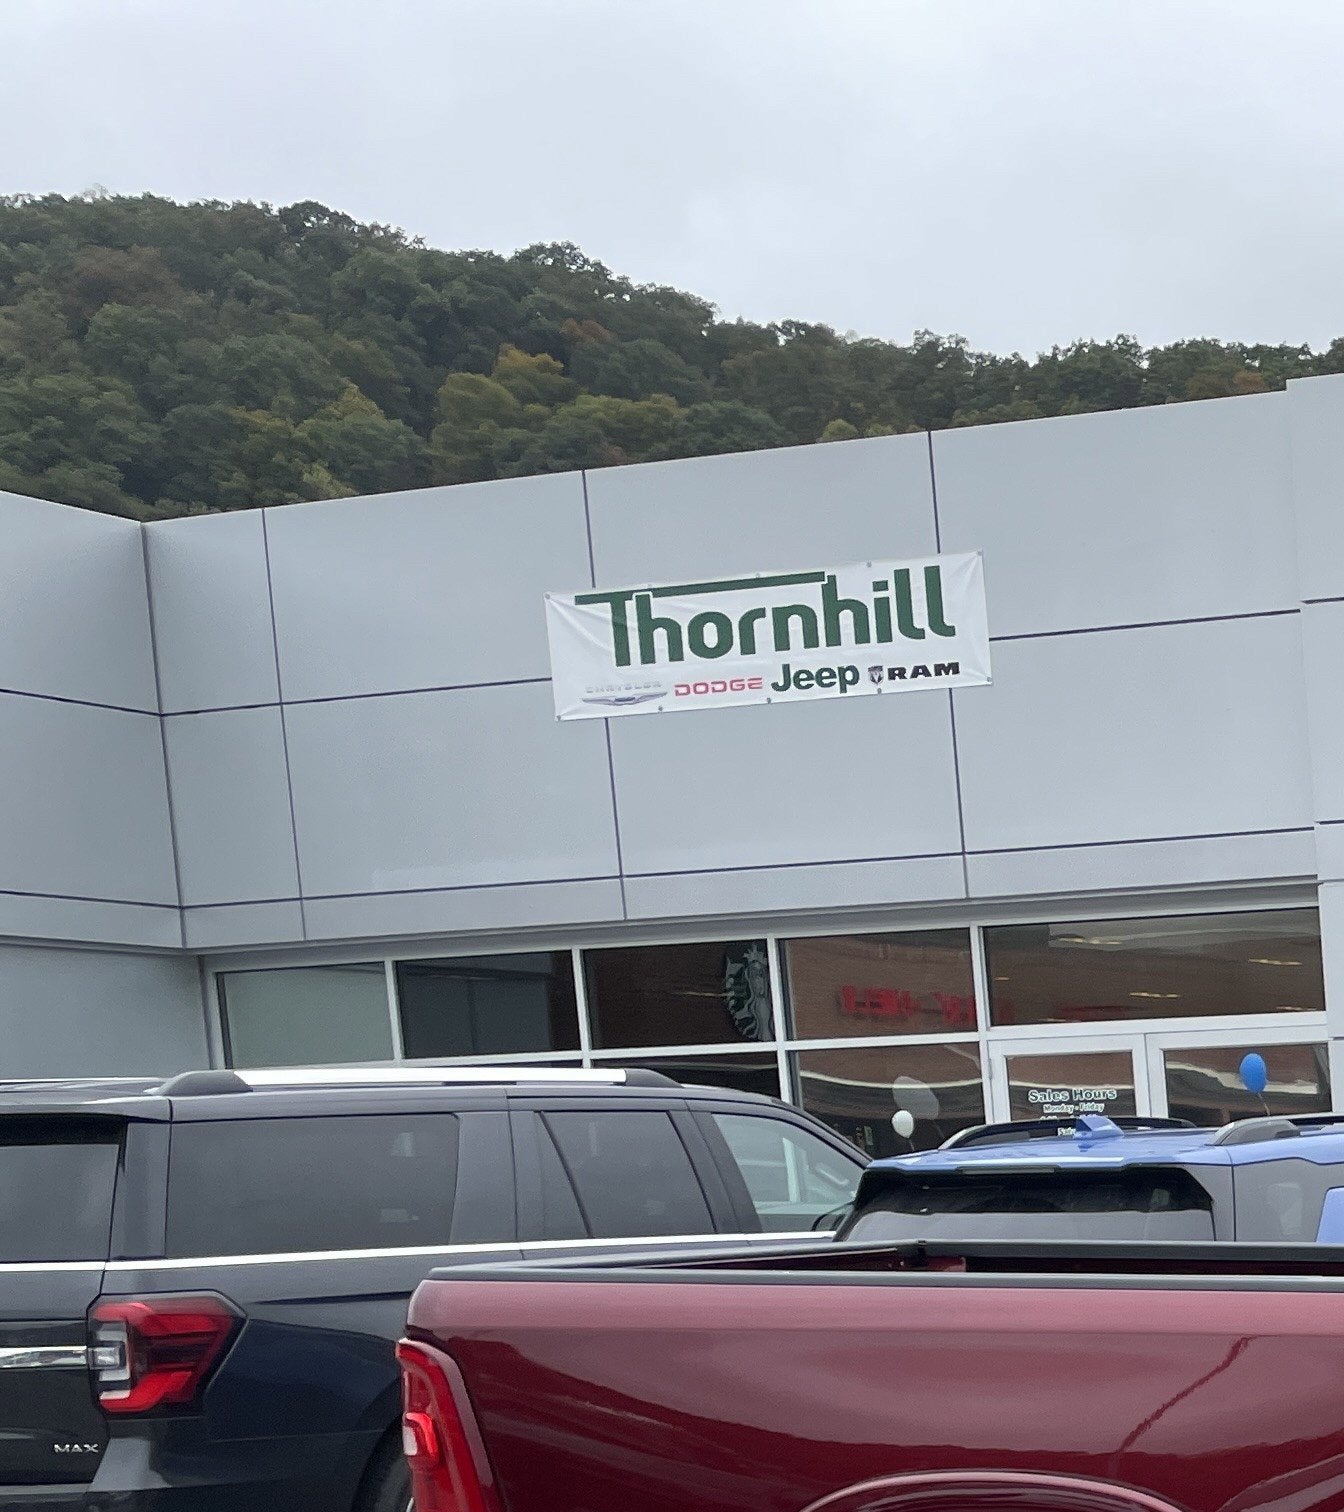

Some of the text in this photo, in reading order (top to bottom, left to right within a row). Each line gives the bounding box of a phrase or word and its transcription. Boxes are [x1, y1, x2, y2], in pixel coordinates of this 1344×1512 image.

[574, 564, 956, 667] Thornhill
[673, 676, 763, 697] DODGE
[770, 662, 860, 694] Jeep
[887, 661, 960, 681] RAM
[1028, 1088, 1118, 1103] Sales Hours
[54, 1444, 99, 1453] MAX
